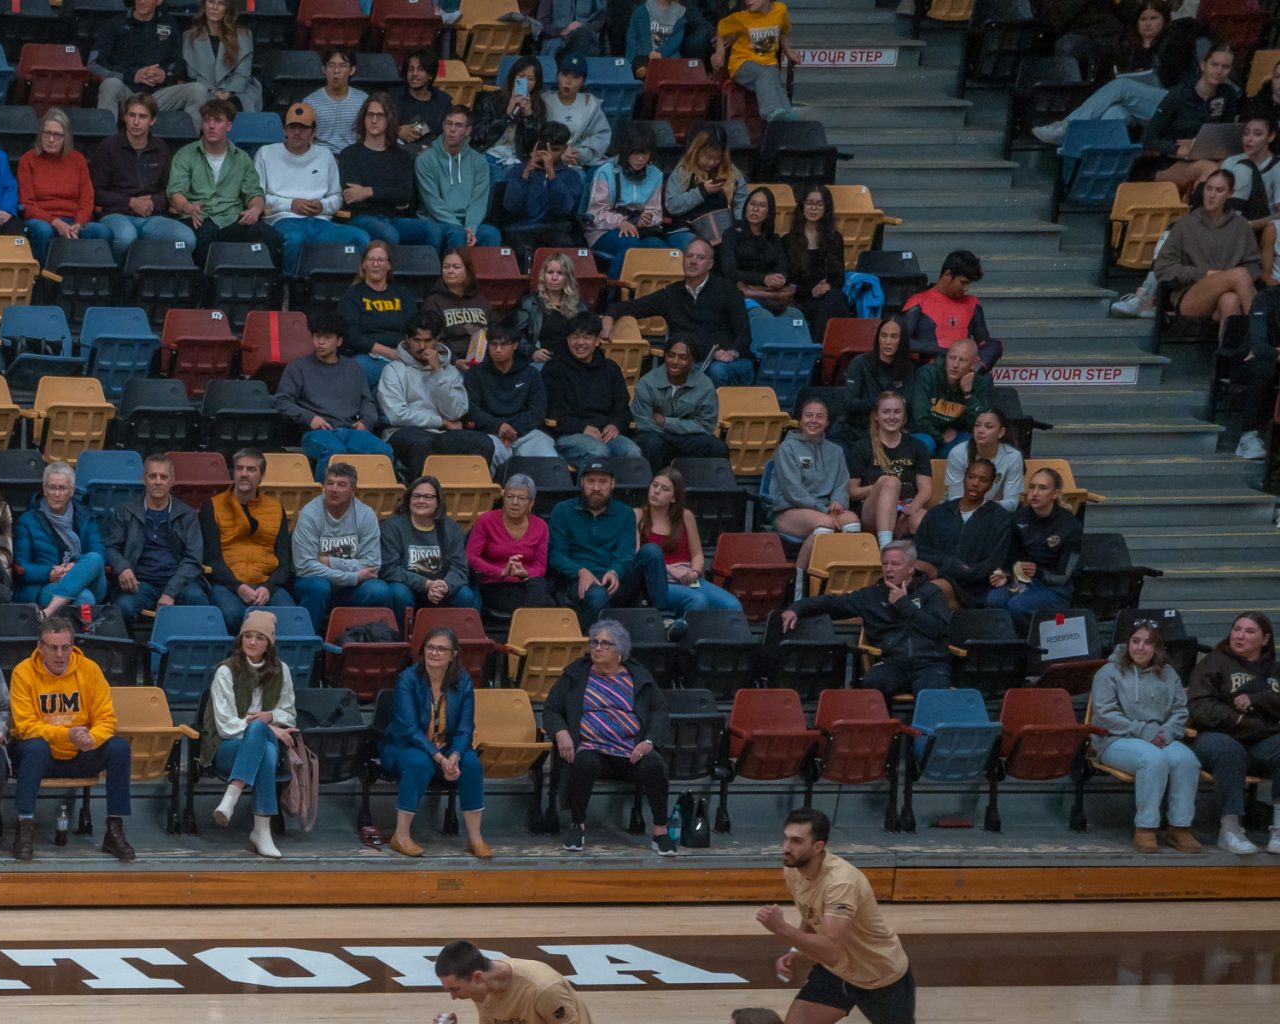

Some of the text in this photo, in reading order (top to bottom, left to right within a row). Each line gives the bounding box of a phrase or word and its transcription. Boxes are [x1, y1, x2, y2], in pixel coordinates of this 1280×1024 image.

[810, 50, 845, 63] YOUR
[849, 50, 883, 62] STEP
[444, 310, 487, 327] BISONS
[991, 368, 1122, 381] WATCH YOUR STEP
[1046, 632, 1080, 643] RESERVED
[39, 692, 80, 714] UM
